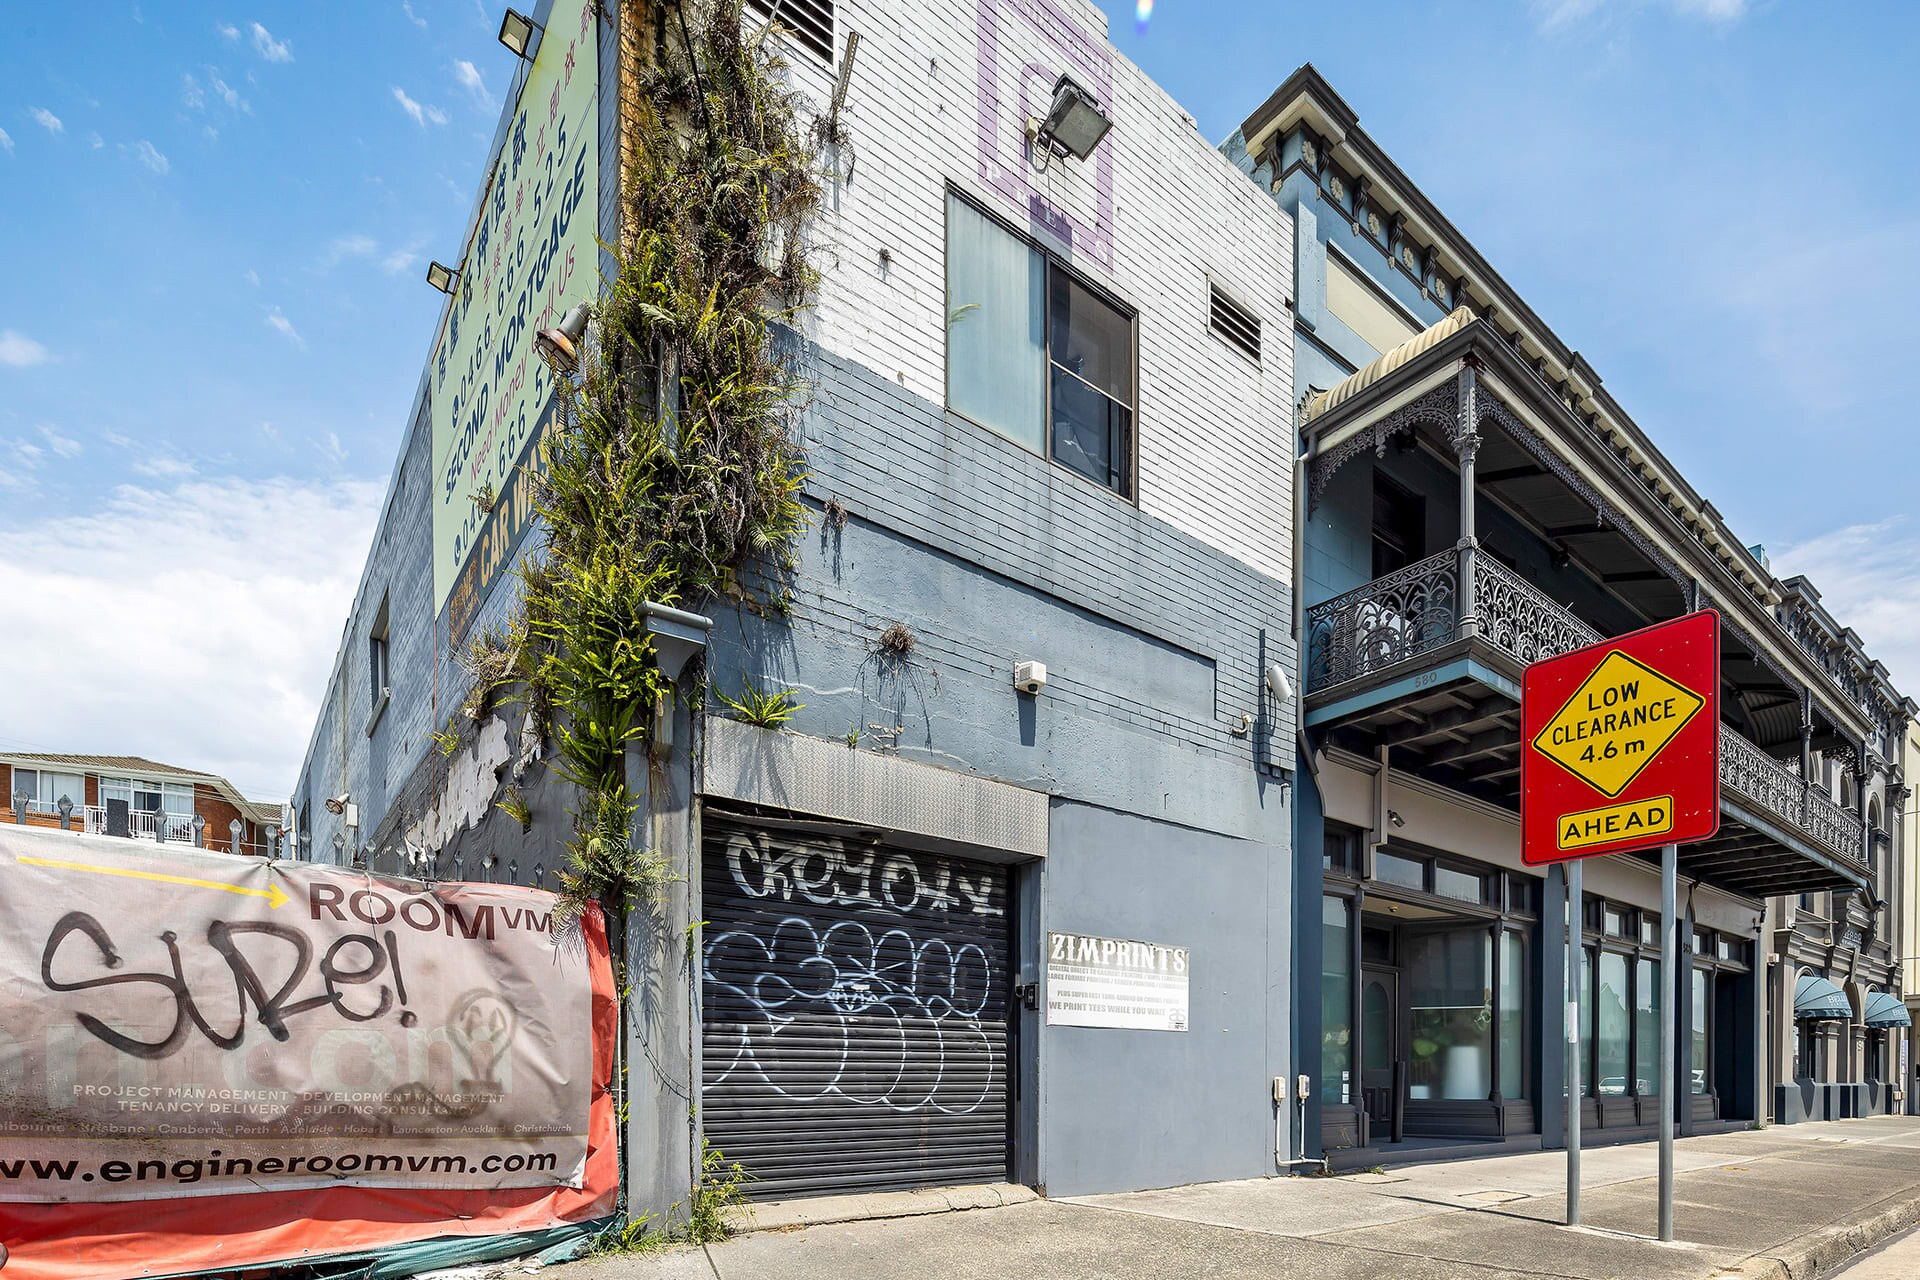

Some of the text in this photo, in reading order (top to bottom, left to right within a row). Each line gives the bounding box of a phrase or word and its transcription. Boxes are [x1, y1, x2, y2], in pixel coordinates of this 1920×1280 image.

[460, 113, 566, 408] 0466 666 525
[445, 382, 489, 504] SECOND
[494, 142, 587, 394] MORTGAGE
[470, 420, 493, 488] Need
[495, 348, 528, 437] Money
[559, 244, 575, 297] Us
[499, 399, 525, 478] 666
[480, 497, 510, 590] CAR
[1414, 672, 1437, 688] 580
[1588, 680, 1640, 712] LOW
[1552, 697, 1677, 746] CLEARANCE
[1579, 739, 1645, 764] 4.6 m
[1563, 807, 1665, 841] AHEAD
[308, 882, 496, 941] ROOM
[1049, 1001, 1166, 1016] WE PRINT TEES WHILE YOU WAIT
[73, 1084, 505, 1104] PROJECT MANAGEMENT DEVELOPMENT MANAGEMENT
[118, 1101, 475, 1116] TENANCY DELIVERY BUILDING CONSULTANCY
[80, 1122, 146, 1134] Brisbane
[158, 1123, 224, 1134] Canberra
[235, 1124, 270, 1134] Perth
[280, 1124, 334, 1135] Adelaide
[343, 1124, 384, 1134] Hobart
[392, 1124, 453, 1134] Launceston
[460, 1124, 505, 1134] Auckland
[514, 1123, 572, 1133] Christchurch
